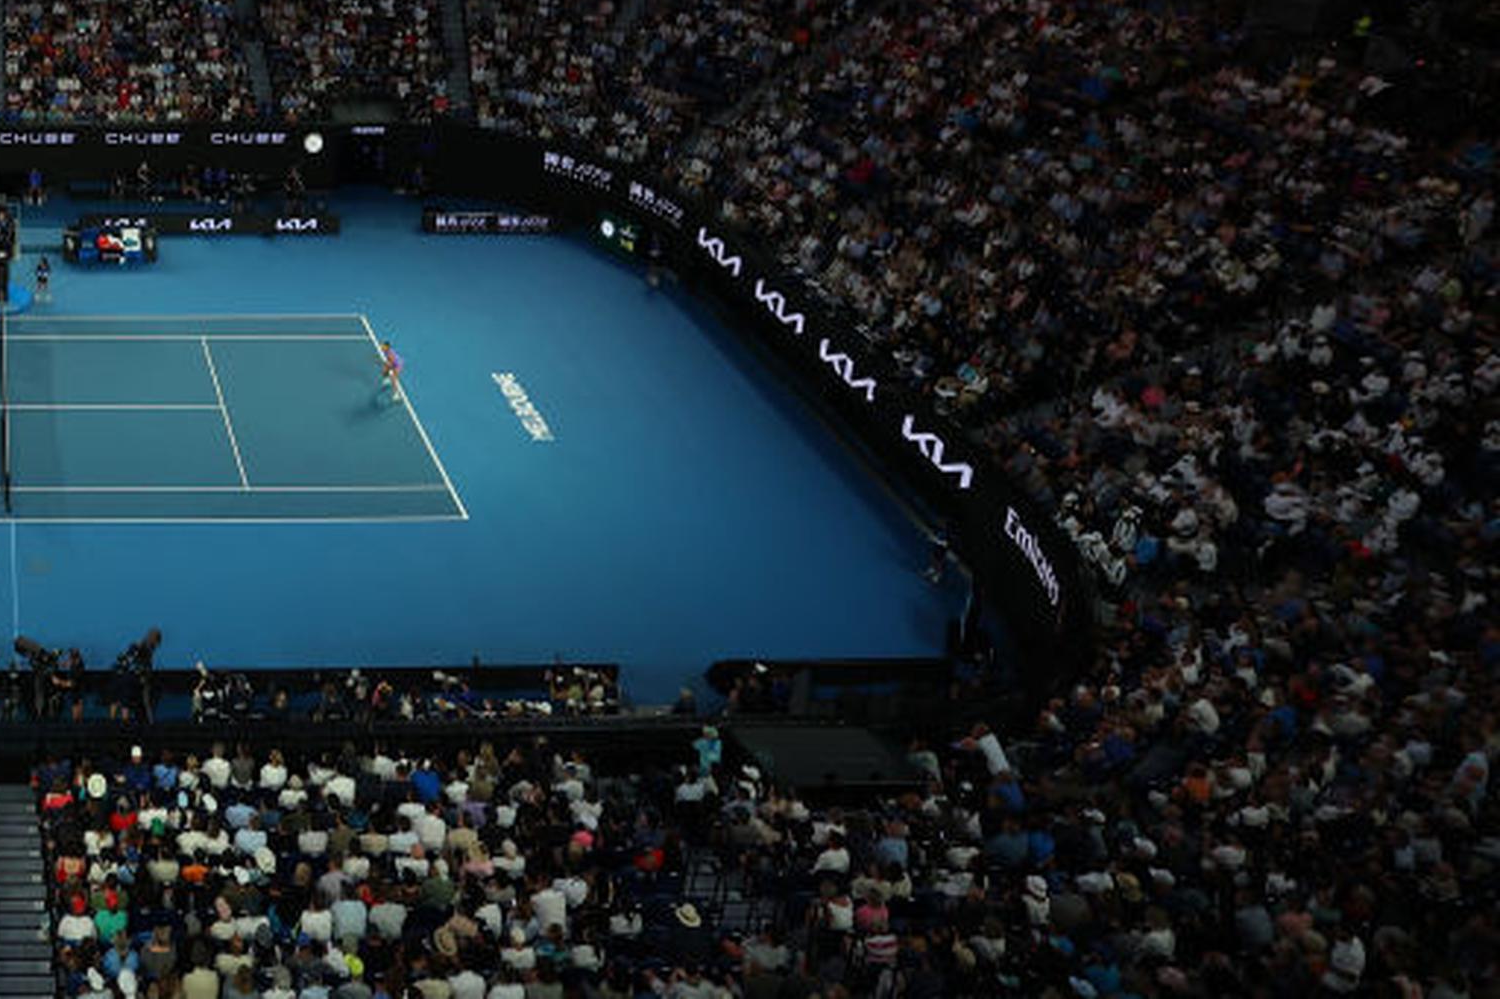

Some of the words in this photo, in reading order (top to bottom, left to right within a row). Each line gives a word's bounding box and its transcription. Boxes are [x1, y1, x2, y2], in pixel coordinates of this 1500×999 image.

[189, 218, 232, 230] KIA
[276, 218, 318, 230] KIA
[697, 227, 742, 276] KIA
[755, 279, 805, 334] KIA
[819, 338, 877, 402] KIA
[901, 415, 973, 489] KIA
